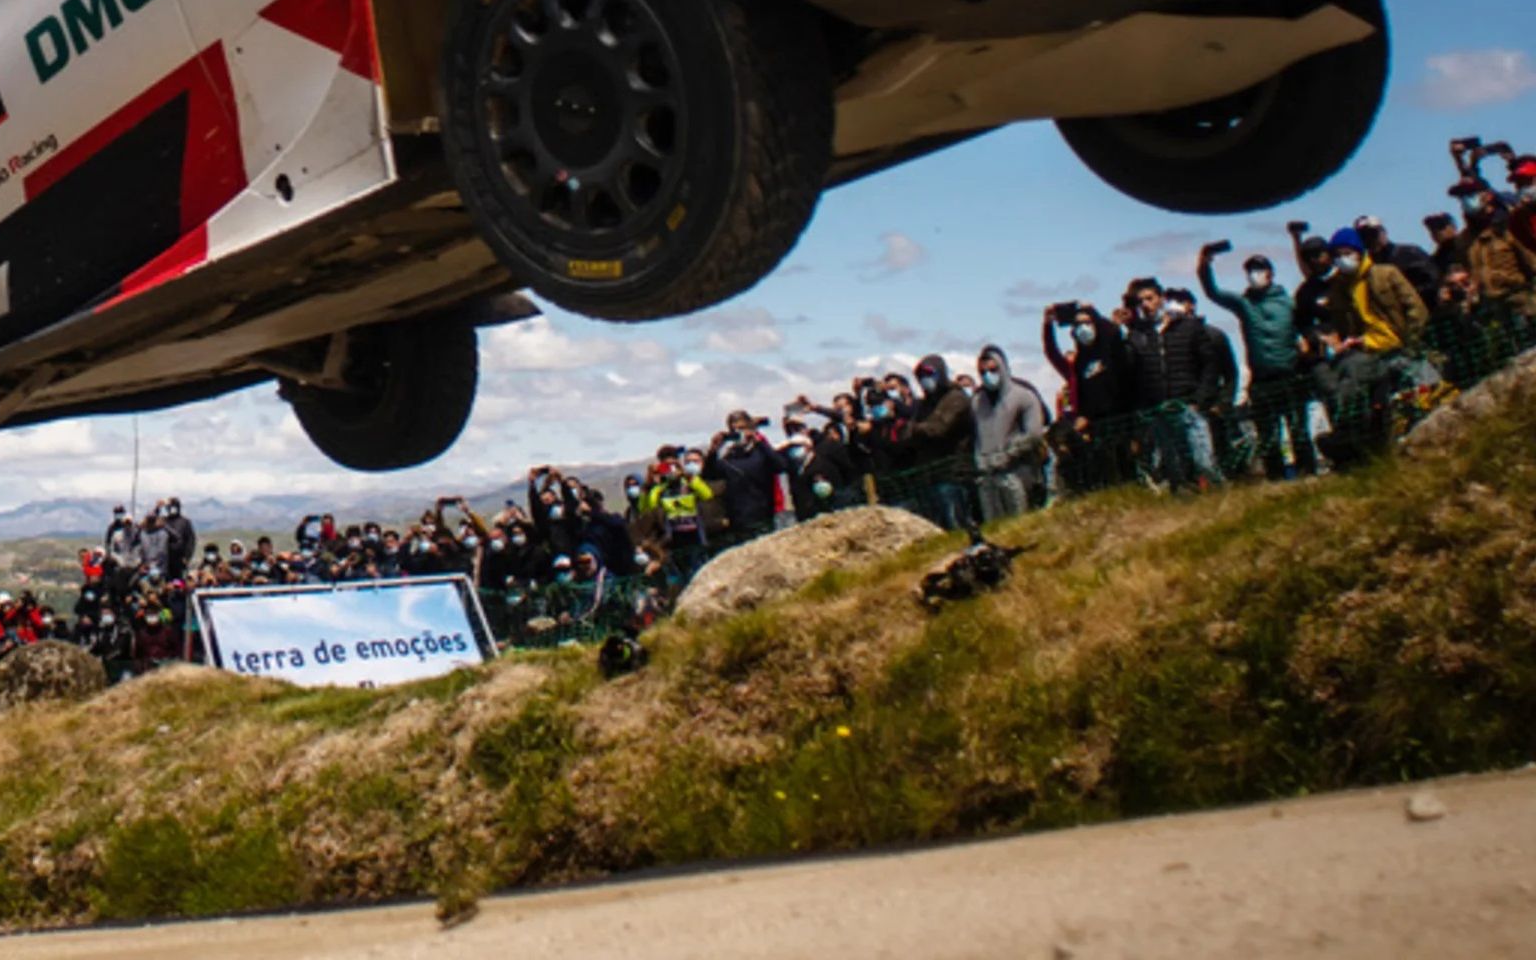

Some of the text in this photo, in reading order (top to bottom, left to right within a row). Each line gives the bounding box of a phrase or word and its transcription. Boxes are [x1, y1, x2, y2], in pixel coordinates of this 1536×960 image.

[232, 629, 468, 674] terra de emoções
